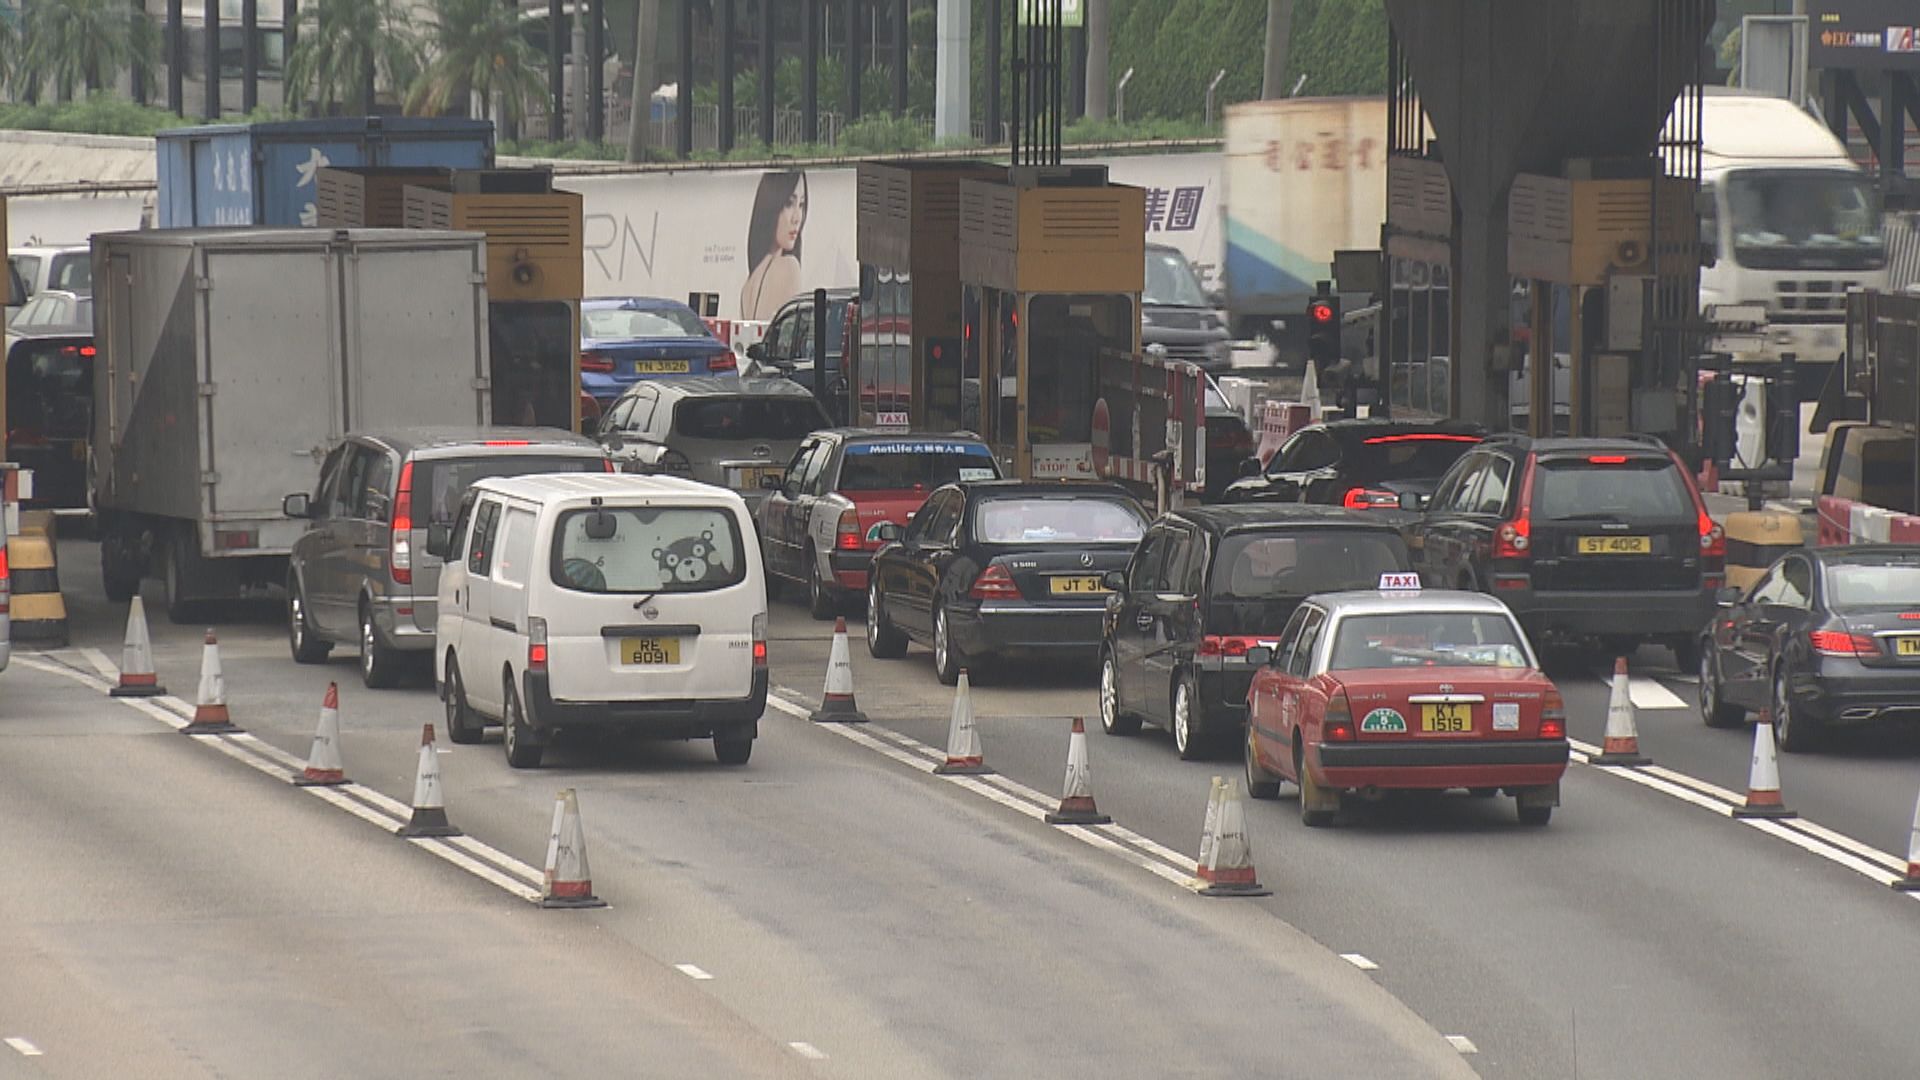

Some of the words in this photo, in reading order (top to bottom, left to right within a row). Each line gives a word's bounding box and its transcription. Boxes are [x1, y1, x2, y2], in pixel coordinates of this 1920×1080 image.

[879, 413, 906, 423] TAXI
[1587, 538, 1605, 551] ST
[1610, 538, 1642, 551] 4012
[1063, 580, 1080, 591] JT
[1384, 575, 1417, 587] TAXI
[640, 639, 660, 651] RE
[633, 652, 669, 664] 8091
[1436, 704, 1456, 717] KT
[1431, 718, 1463, 731] 1519
